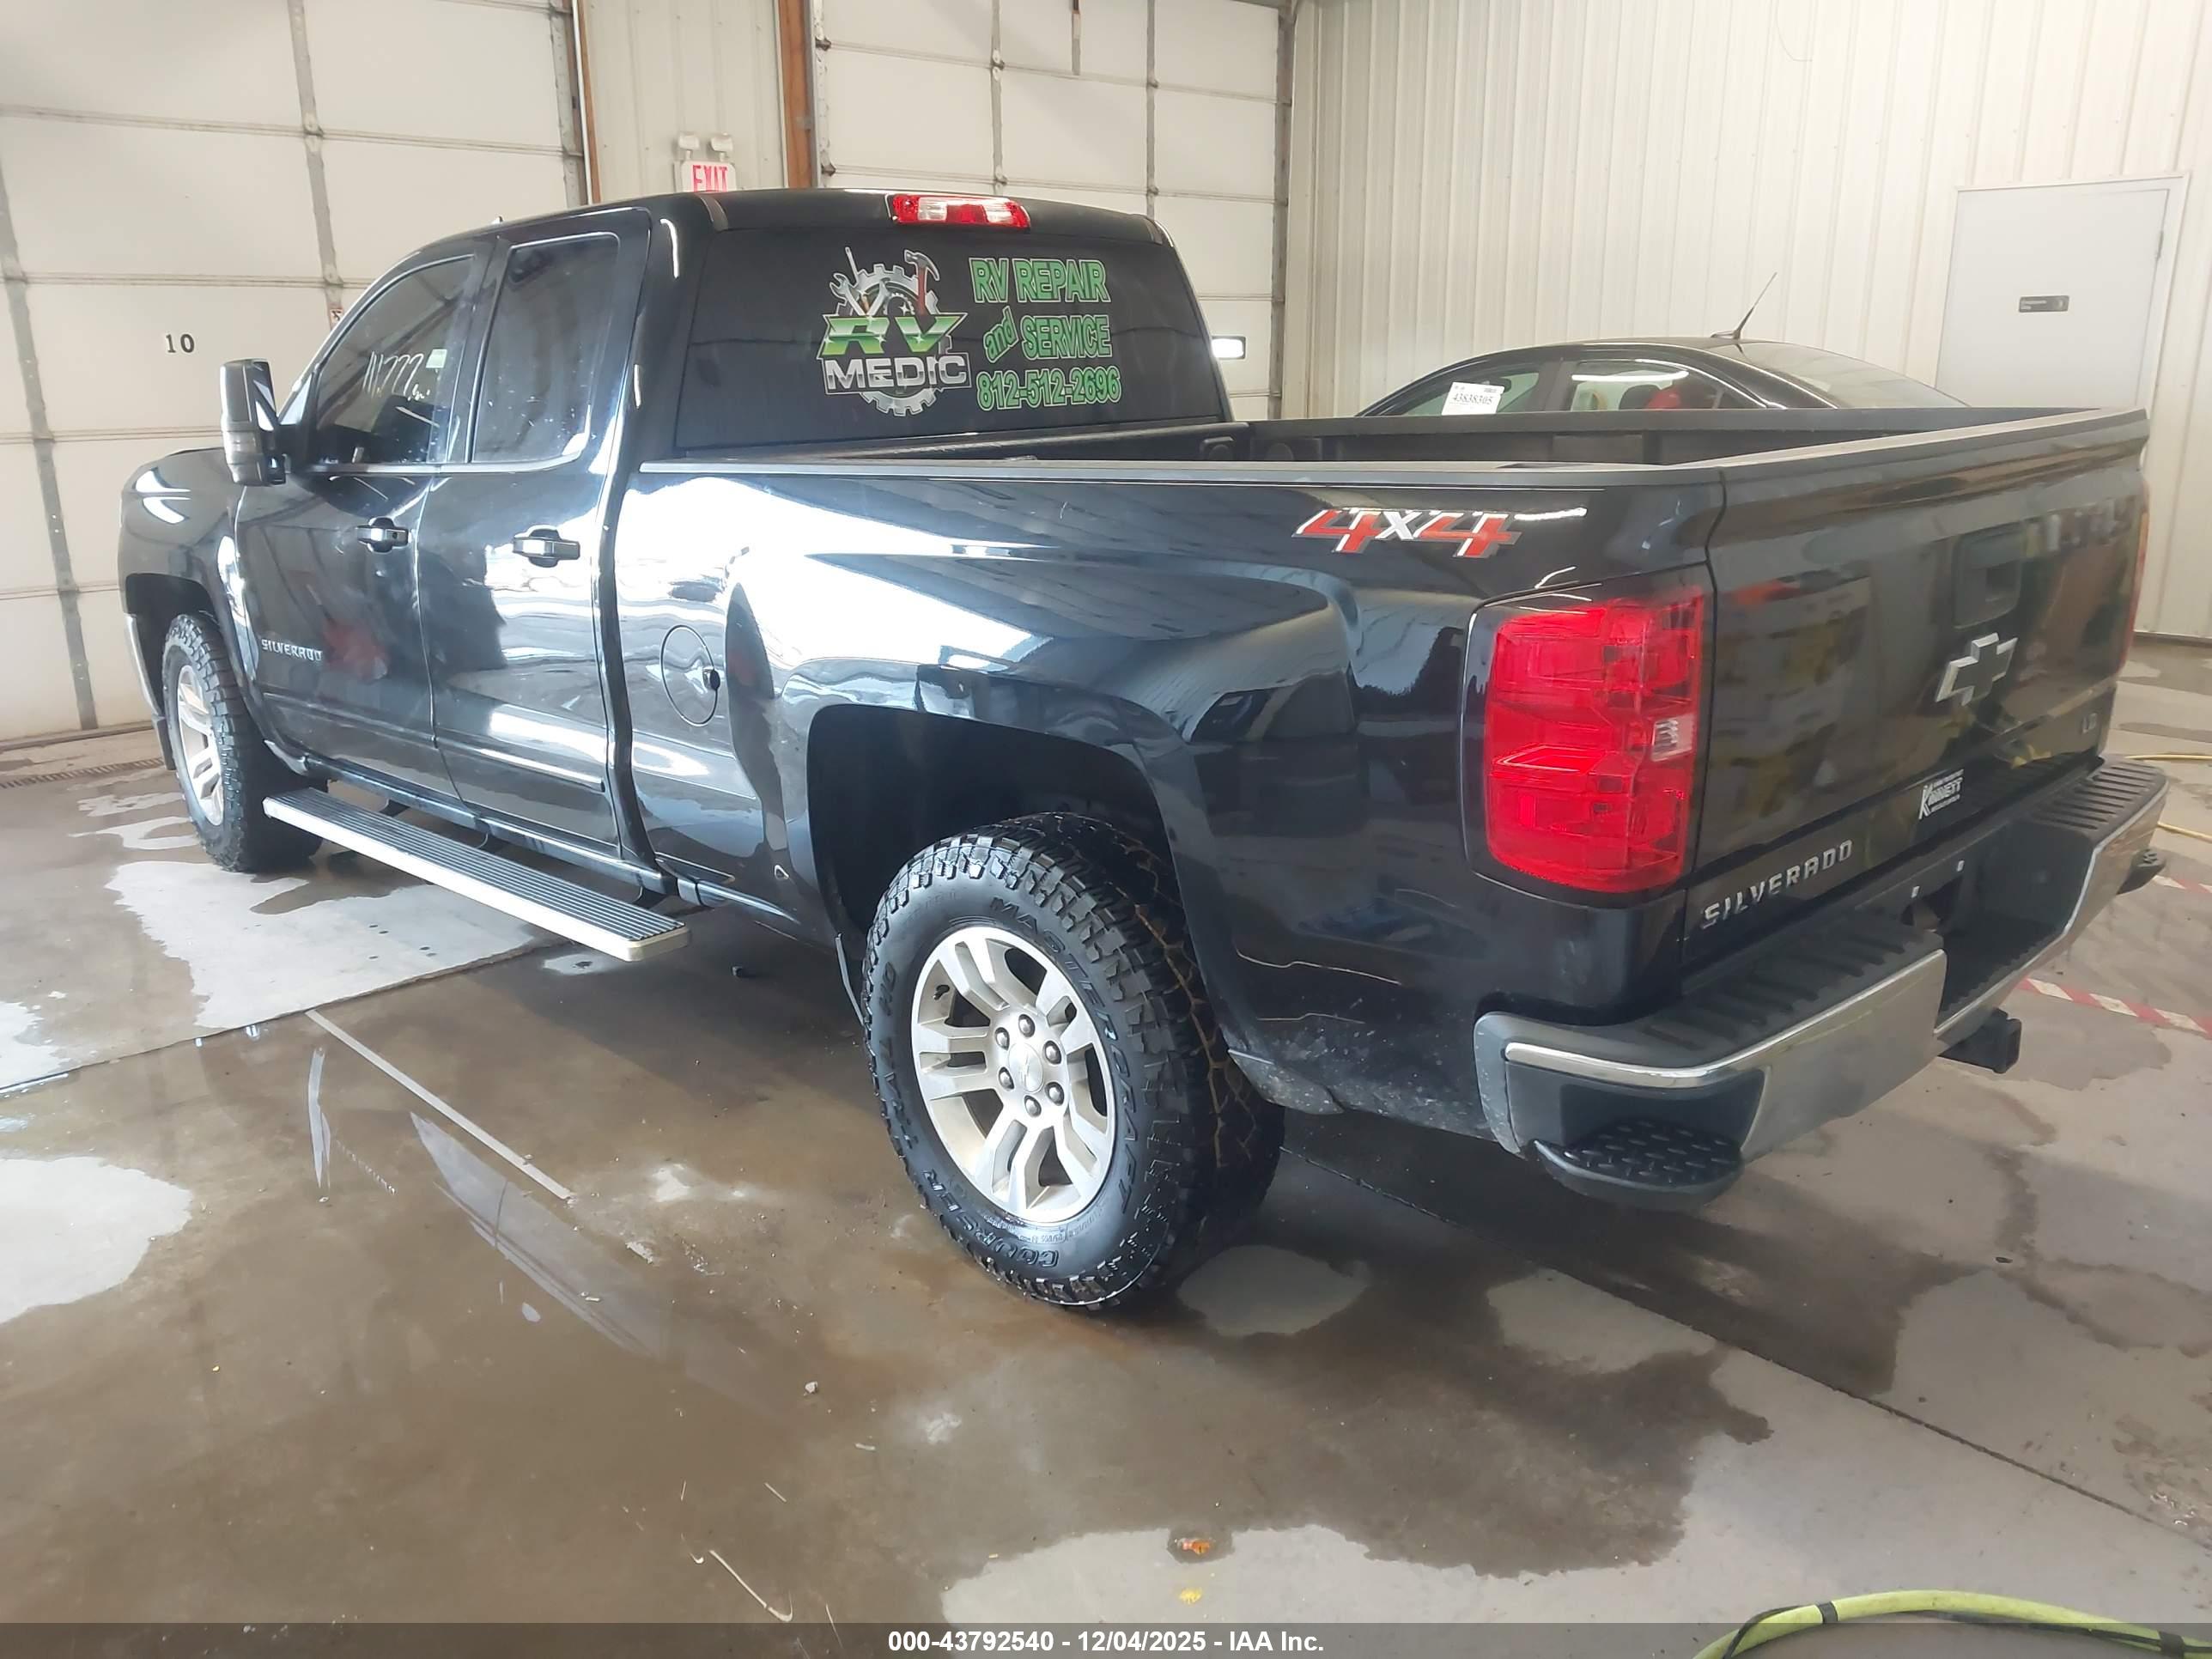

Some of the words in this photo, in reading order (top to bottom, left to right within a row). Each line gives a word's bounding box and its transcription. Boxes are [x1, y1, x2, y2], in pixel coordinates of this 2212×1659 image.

[692, 164, 728, 192] EXIT
[969, 258, 1009, 303] RV
[1012, 258, 1111, 303] REPAIR
[166, 333, 195, 353] 10
[821, 315, 962, 356] RV
[983, 306, 1019, 363] and
[1020, 314, 1113, 361] SERVICE
[824, 355, 968, 390] MEDIC
[976, 366, 1121, 410] 812-512-2696
[261, 639, 323, 660] SILVERADO
[1701, 839, 1853, 929] SILVERADO
